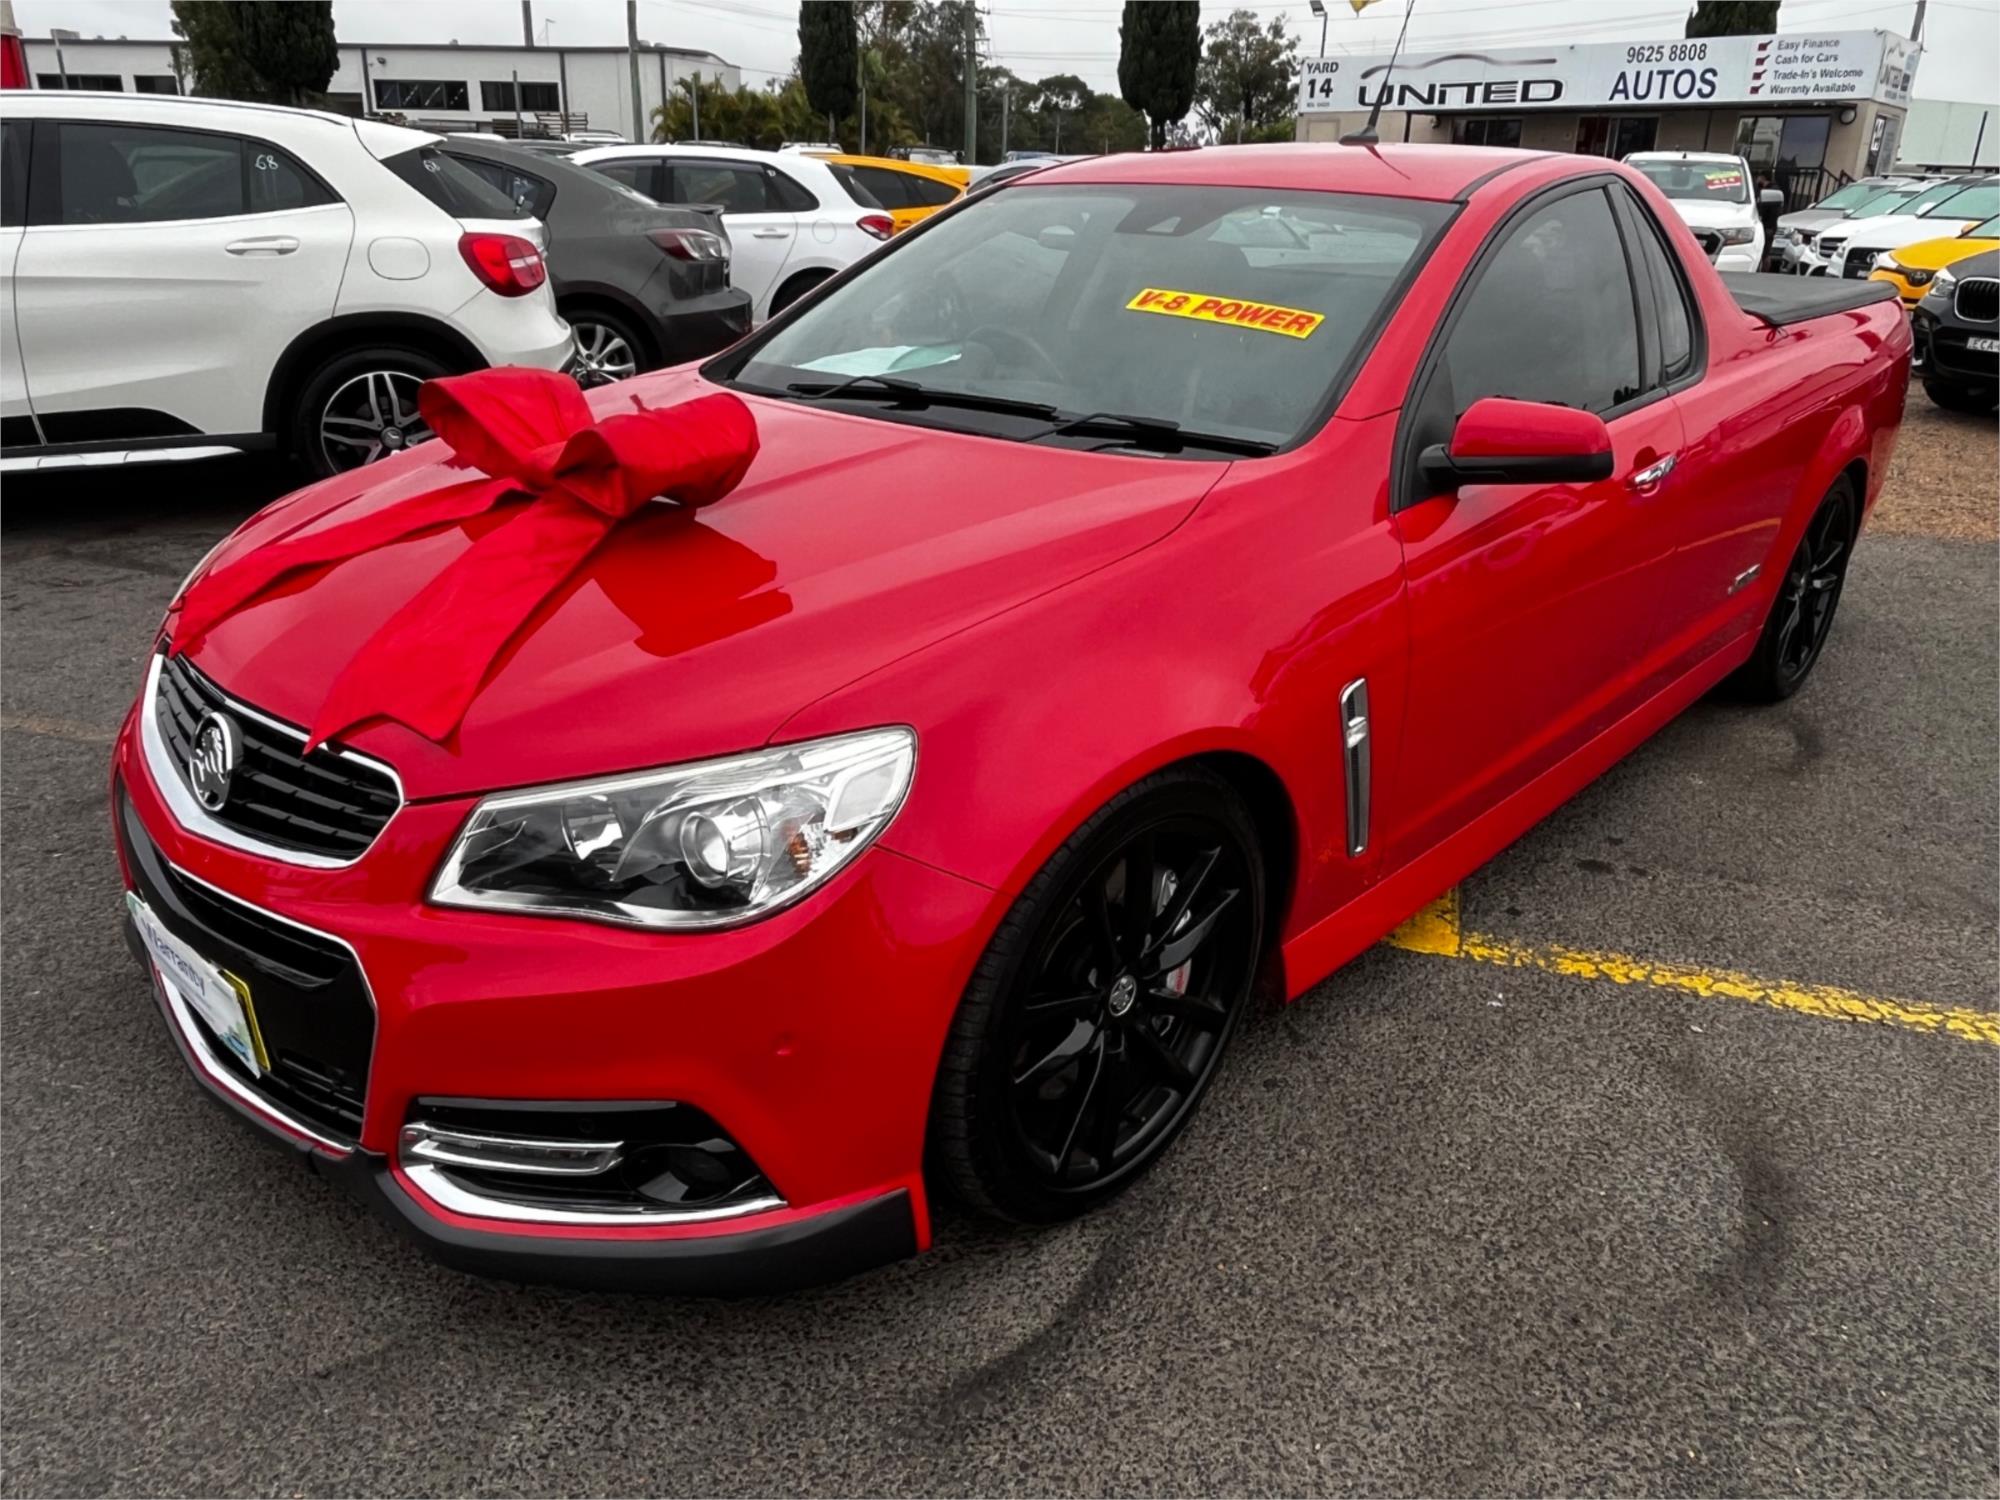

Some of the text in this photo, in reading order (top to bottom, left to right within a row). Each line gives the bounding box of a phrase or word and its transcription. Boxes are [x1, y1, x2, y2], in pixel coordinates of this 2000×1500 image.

[1777, 38, 1840, 52] Easy Finance
[1626, 43, 1707, 63] 9625 8808
[1775, 53, 1839, 64] Cash for Cars
[1307, 62, 1339, 74] YARD
[1821, 68, 1864, 78] Welcome
[1308, 78, 1333, 98] 14
[1609, 67, 1718, 101] AUTOS
[1770, 83, 1856, 95] Warranty Available
[255, 154, 279, 170] 68
[1136, 291, 1316, 332] V-8 POWER
